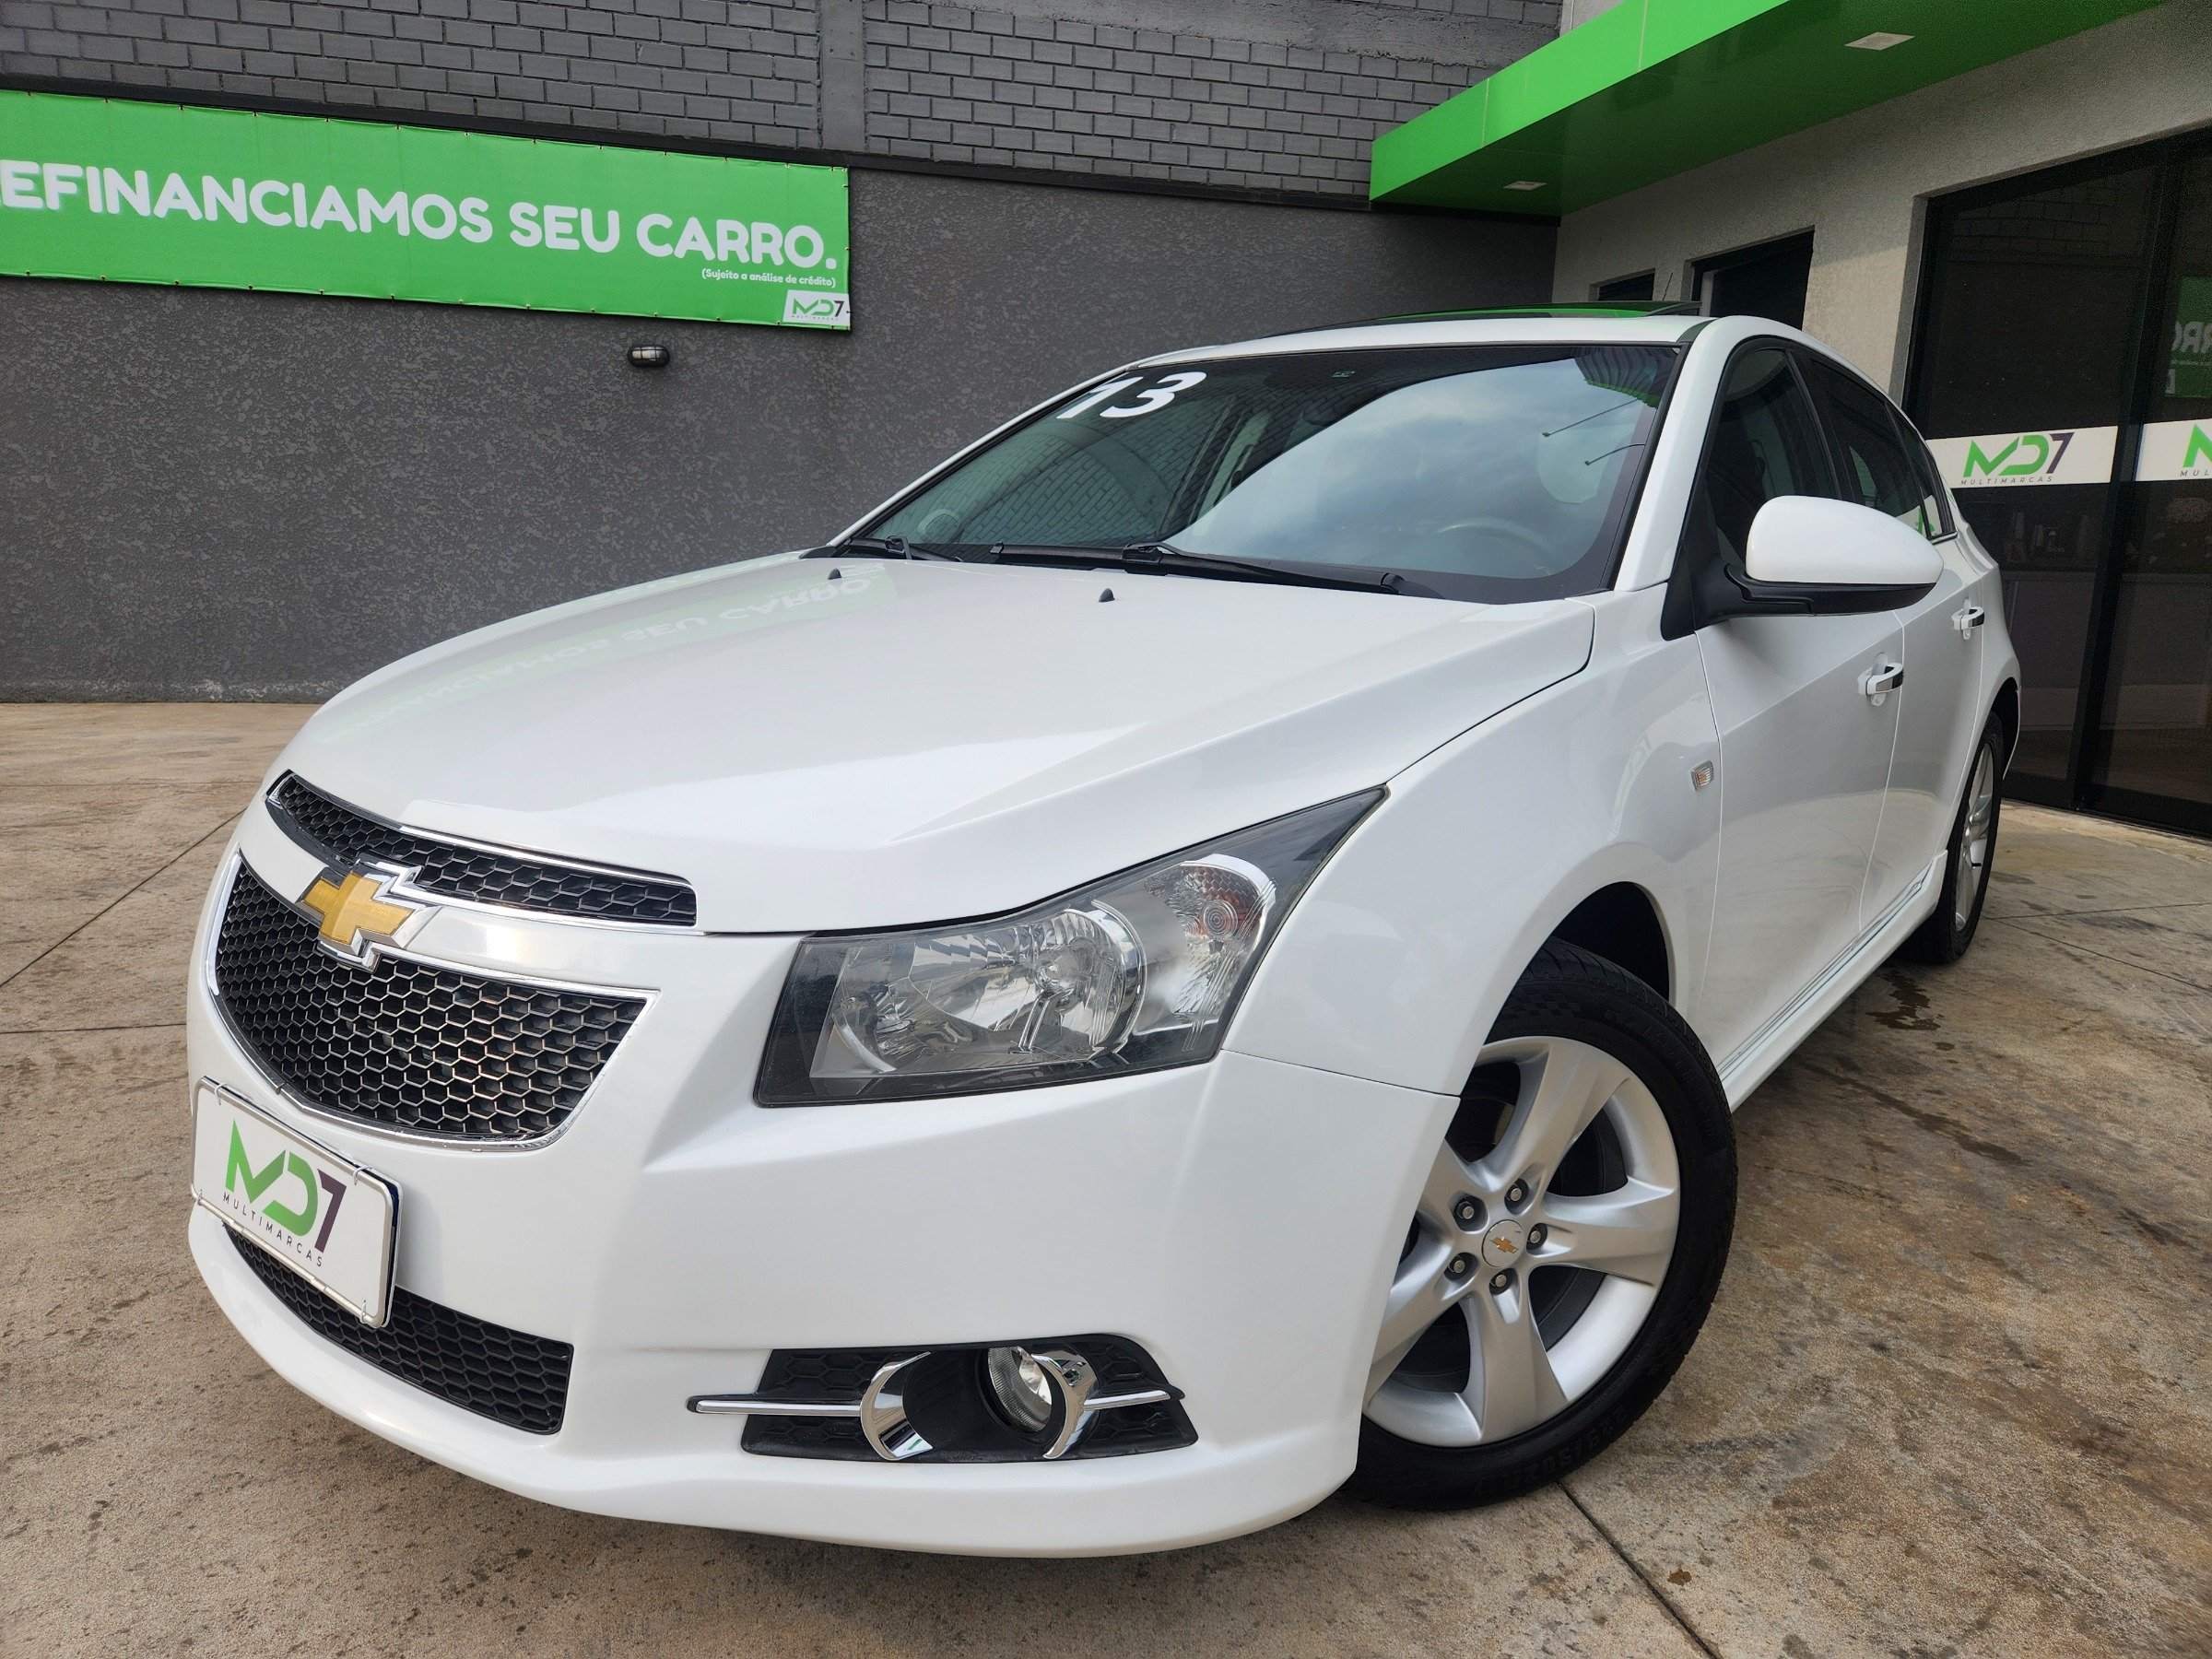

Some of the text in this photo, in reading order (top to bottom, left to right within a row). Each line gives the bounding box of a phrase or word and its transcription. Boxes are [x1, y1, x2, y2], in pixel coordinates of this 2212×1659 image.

[0, 159, 836, 269] EFINANCIAMOS SEU CARRO.
[701, 267, 738, 281] (Sujeito
[749, 272, 783, 283] análise
[785, 274, 797, 284] de
[799, 275, 836, 288] crédito)
[793, 298, 844, 317] MD7
[1056, 371, 1206, 418] 13
[1963, 431, 2075, 477] MD7
[1960, 476, 2053, 486] MULTIMARCAS
[225, 1118, 347, 1253] MD7
[223, 1191, 324, 1267] MULTIMARCAS
